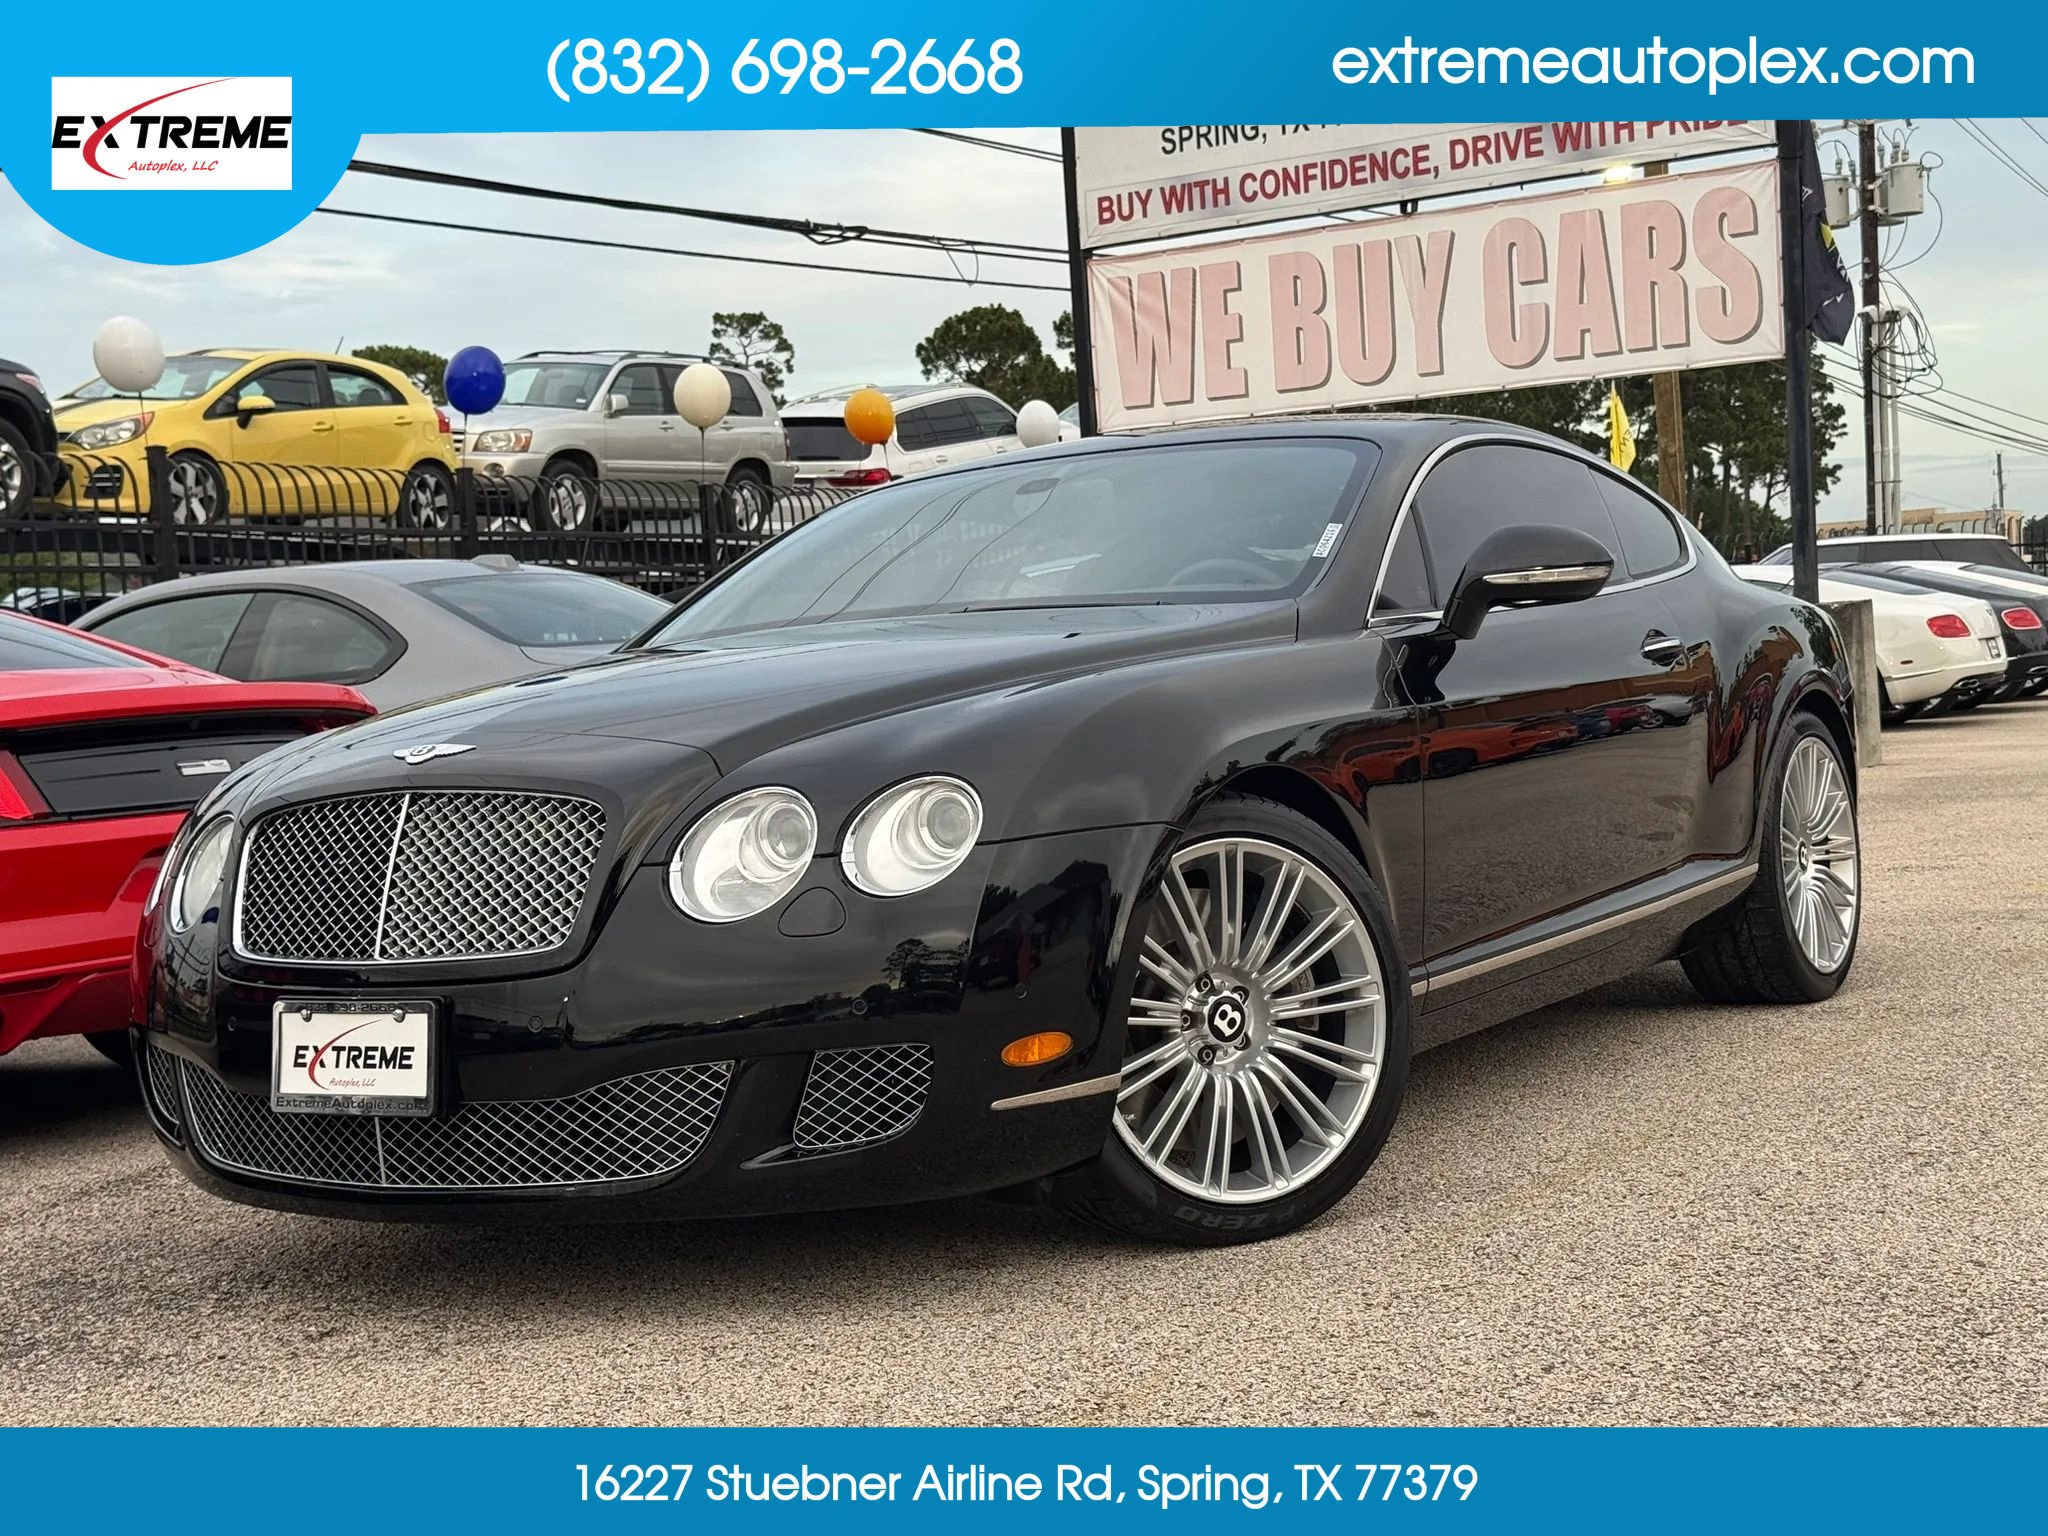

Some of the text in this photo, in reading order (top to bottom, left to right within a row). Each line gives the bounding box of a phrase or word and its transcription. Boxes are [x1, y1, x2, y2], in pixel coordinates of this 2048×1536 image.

[1160, 124, 1268, 156] SPRING,
[1096, 187, 1154, 226] BUY
[1158, 175, 1231, 216] WITH
[1239, 143, 1440, 204] CONFIDENCE,
[1448, 124, 1545, 171] DRIVE
[1551, 121, 1636, 154] WITH
[1107, 259, 1250, 411] WE
[1267, 229, 1456, 394] BUY
[1482, 185, 1763, 370] CARS
[1213, 1003, 1242, 1038] B
[293, 1044, 416, 1071] EXTREME
[1174, 1205, 1271, 1230] ZERO
